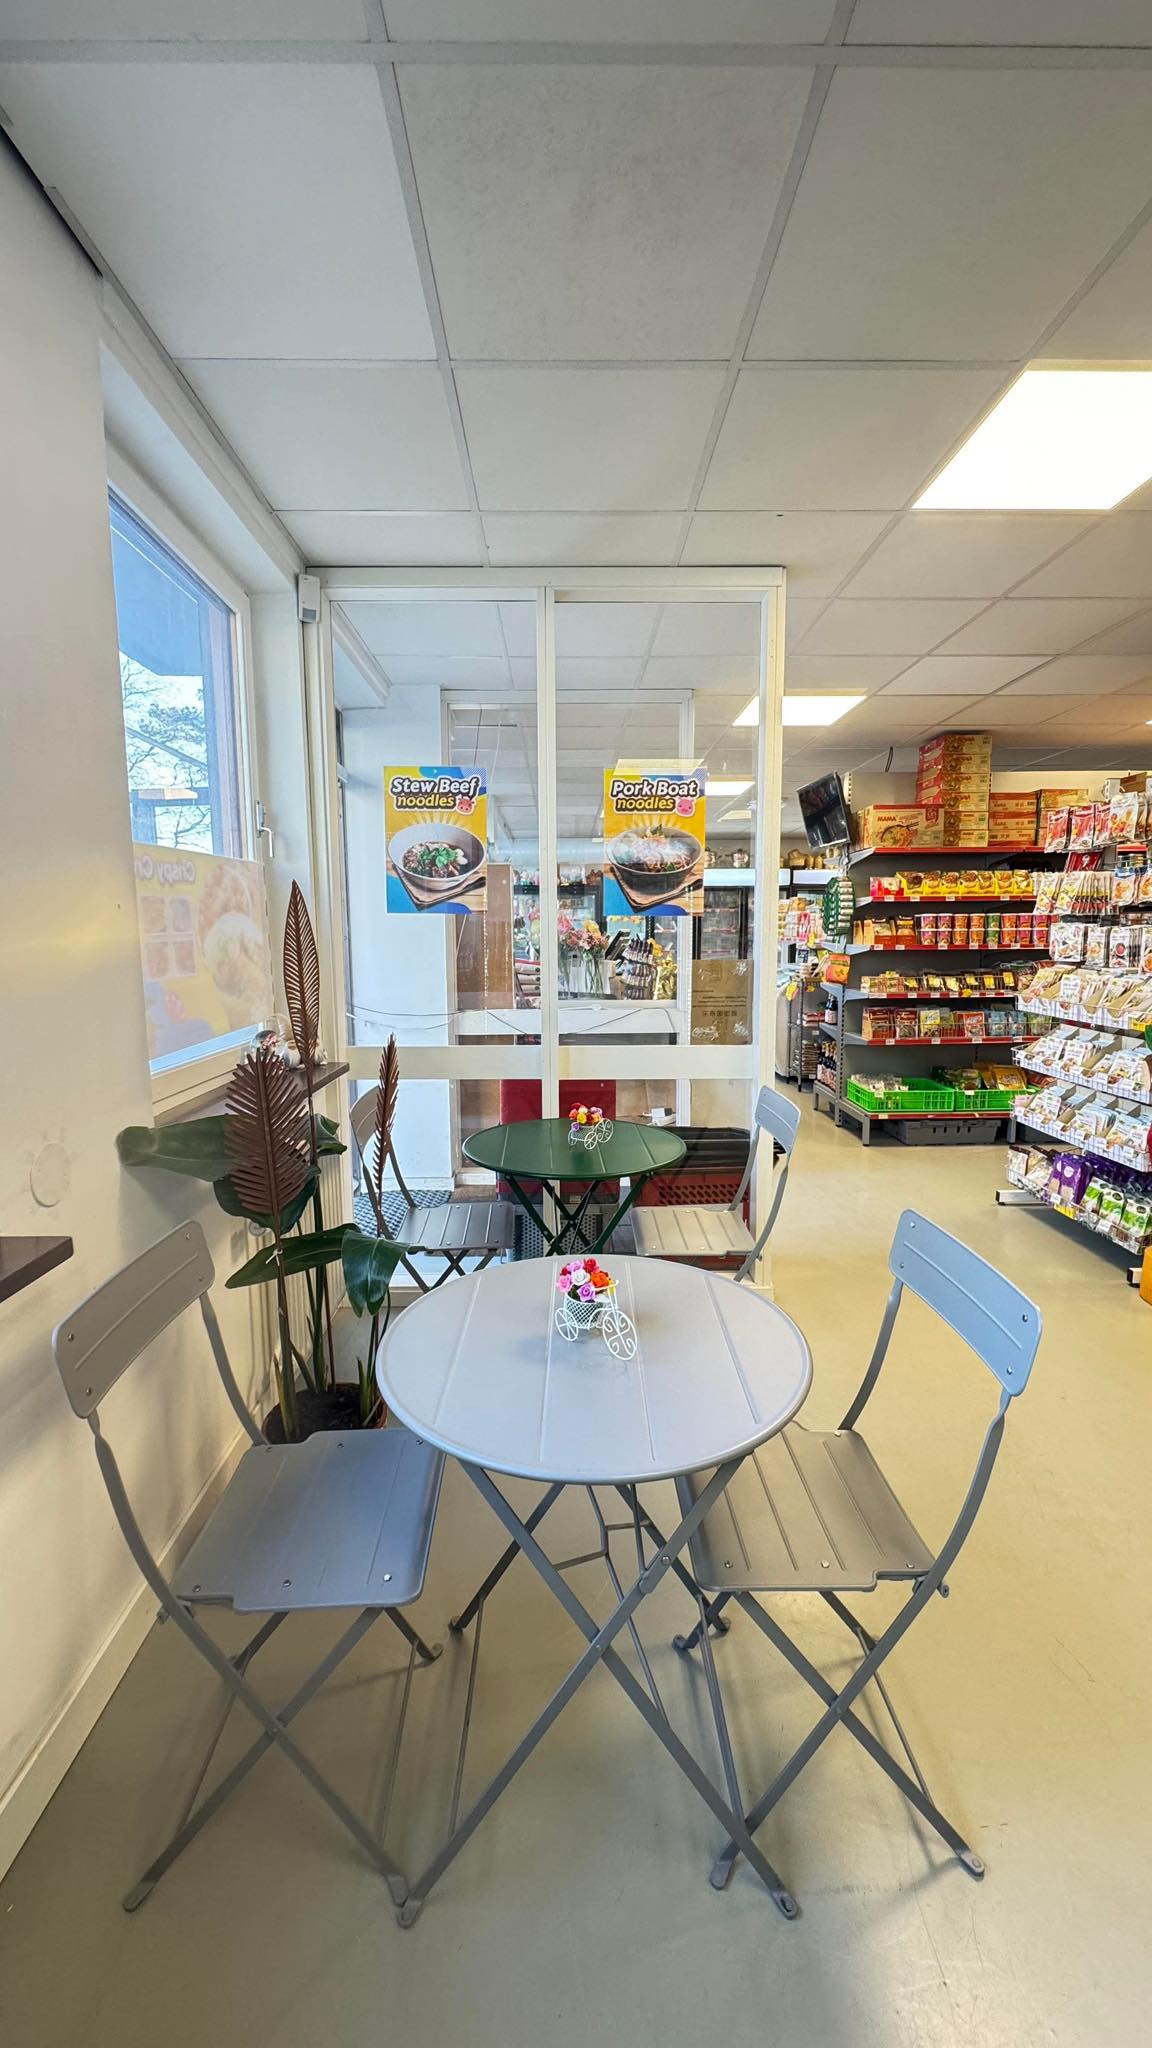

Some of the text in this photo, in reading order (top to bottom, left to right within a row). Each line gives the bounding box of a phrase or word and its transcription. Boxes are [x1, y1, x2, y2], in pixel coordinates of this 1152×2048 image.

[391, 777, 478, 796] Stew Beef
[612, 780, 697, 796] Pork Boat
[397, 794, 455, 807] noodles
[616, 796, 674, 809] noodles
